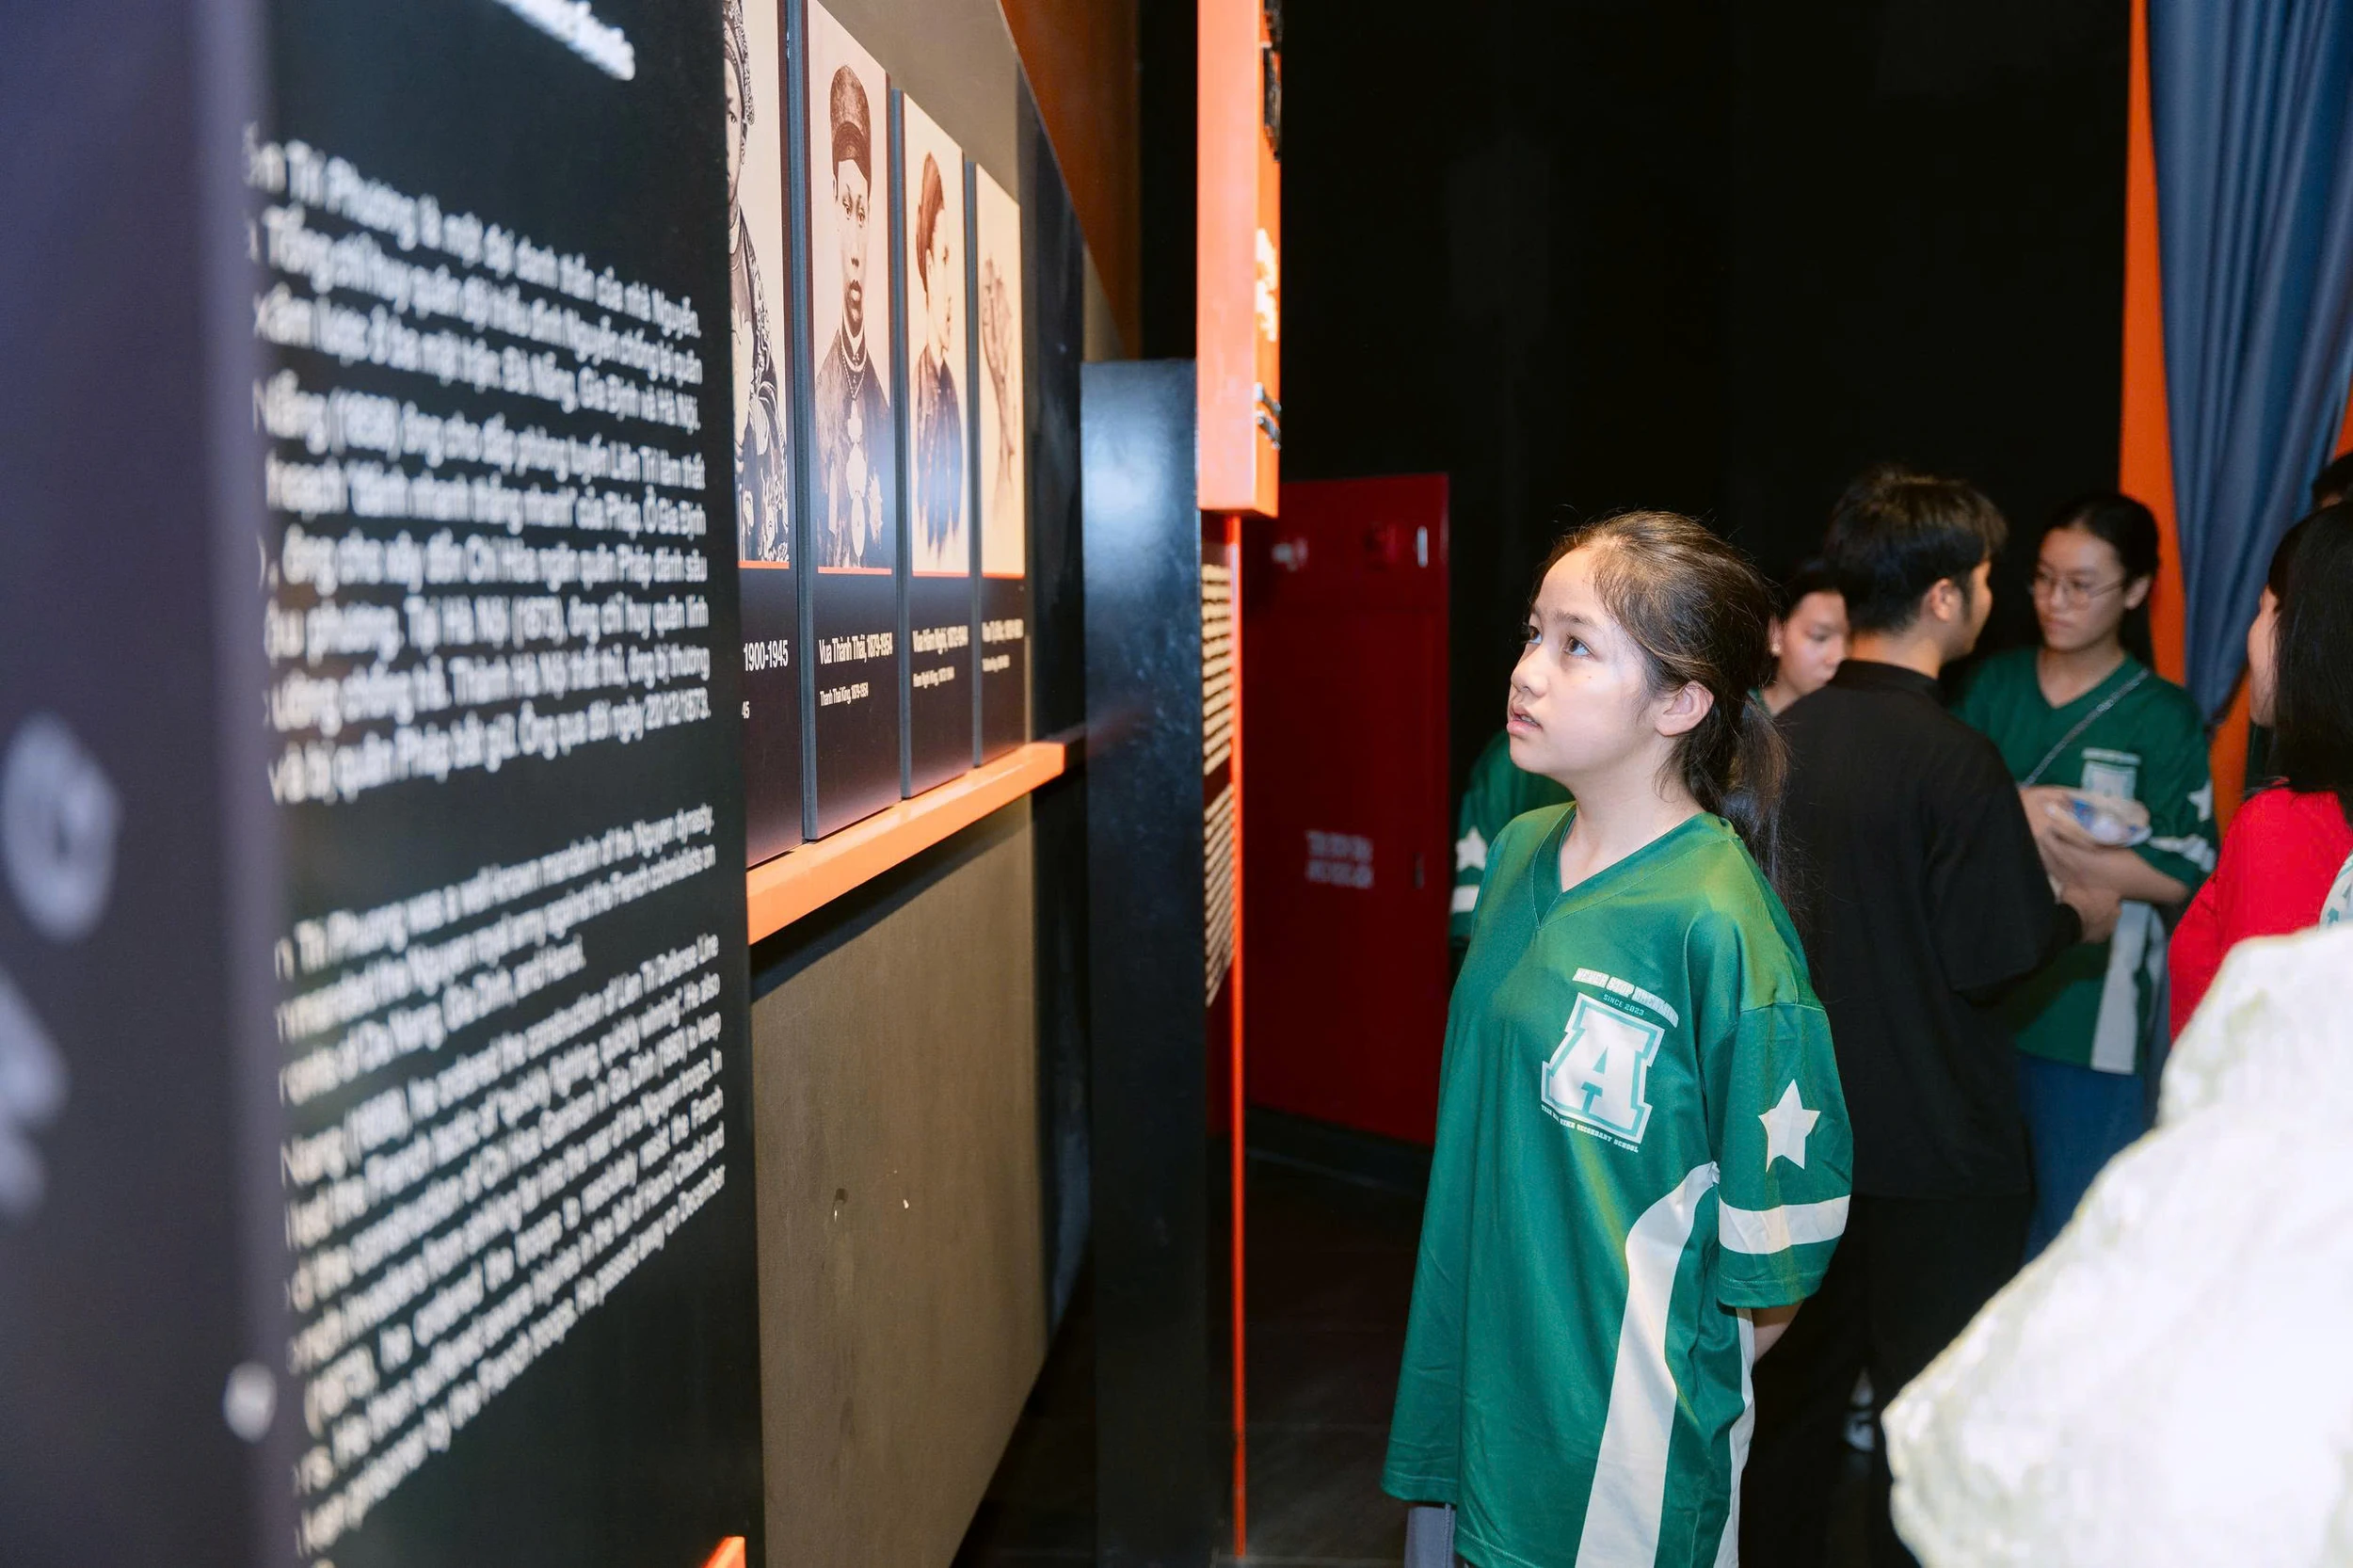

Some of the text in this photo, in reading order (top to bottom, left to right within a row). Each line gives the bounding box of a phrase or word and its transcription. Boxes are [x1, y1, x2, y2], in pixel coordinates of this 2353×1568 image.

[744, 639, 789, 672] 1900-1945
[819, 639, 832, 664] Vua
[832, 636, 852, 663] Thành
[820, 689, 833, 706] Thanh
[1603, 994, 1644, 1016] SINCE 2023
[1541, 992, 1665, 1144] A
[1613, 1139, 1639, 1153] SCHOOL
